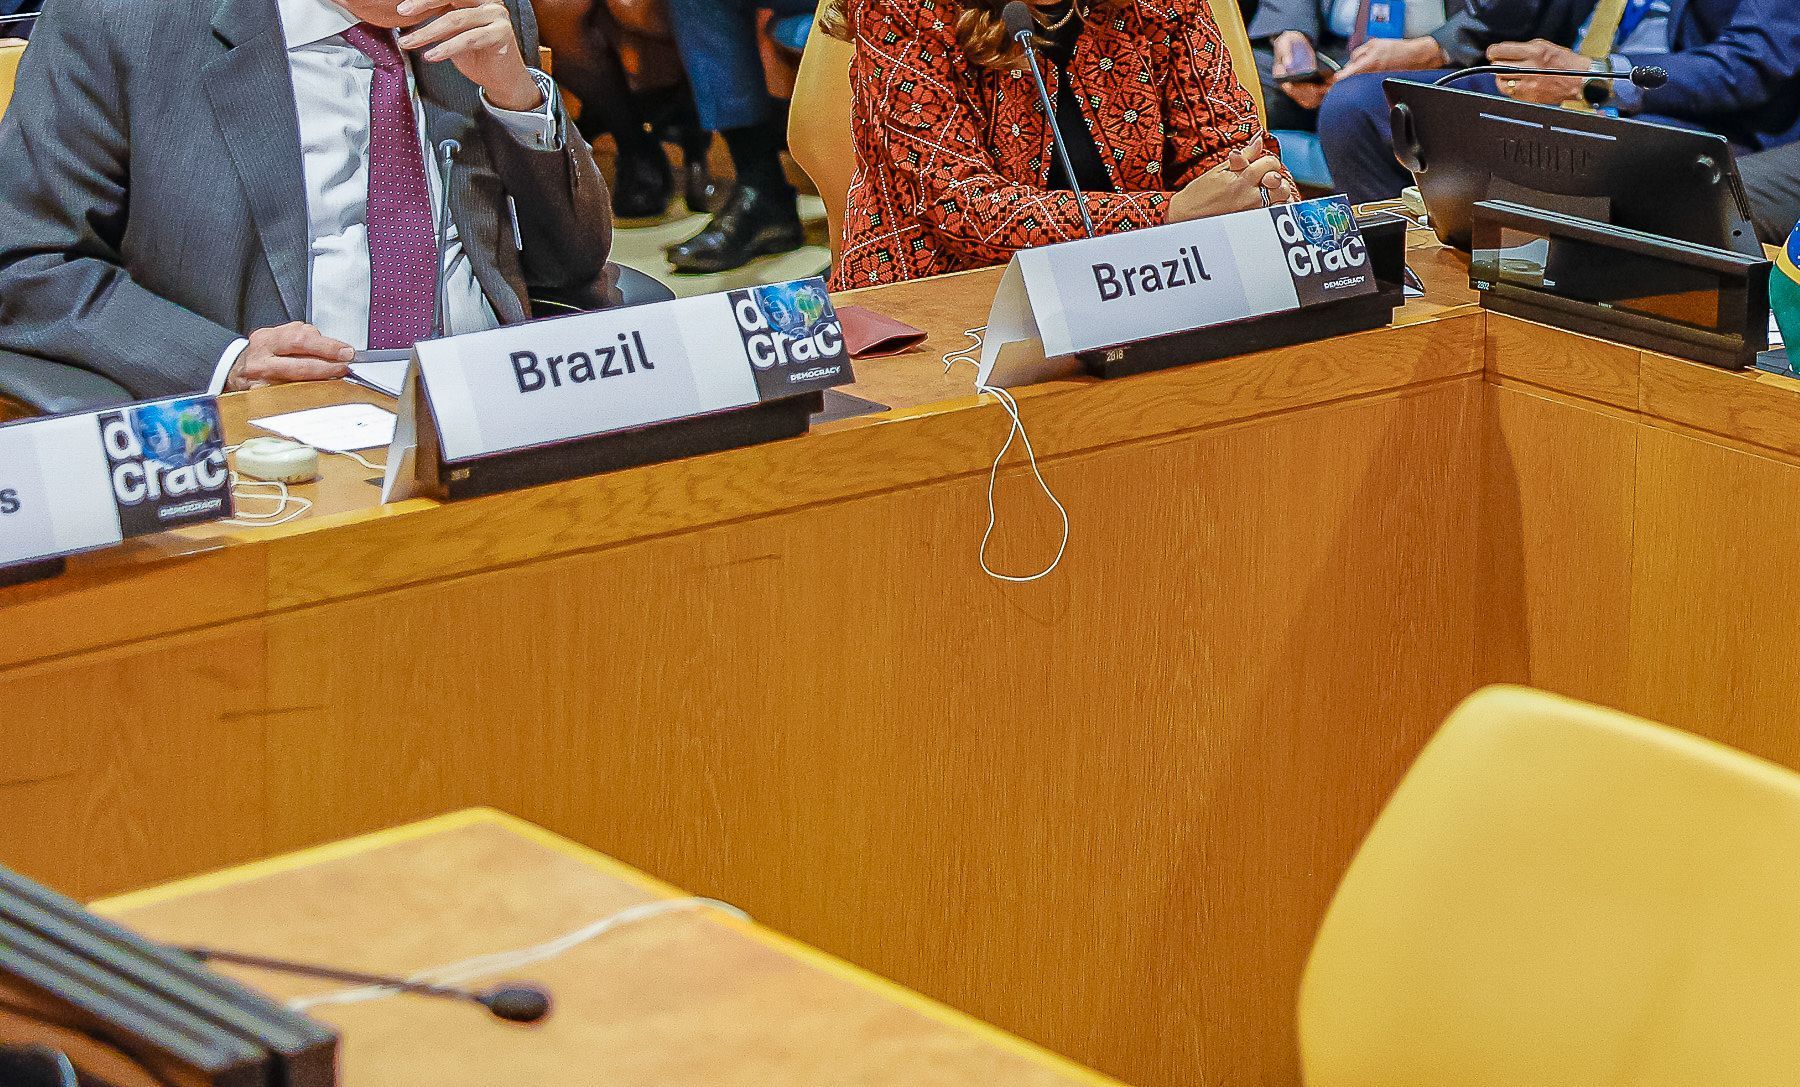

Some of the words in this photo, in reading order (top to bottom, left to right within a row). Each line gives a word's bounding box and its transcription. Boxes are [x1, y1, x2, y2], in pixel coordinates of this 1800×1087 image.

[1092, 245, 1212, 302] Brazil
[1288, 235, 1366, 276] crac
[1323, 276, 1365, 289] DEMOCRACY
[510, 331, 655, 393] Brazil
[748, 320, 842, 369] crac
[790, 365, 841, 381] DEMOCRACY
